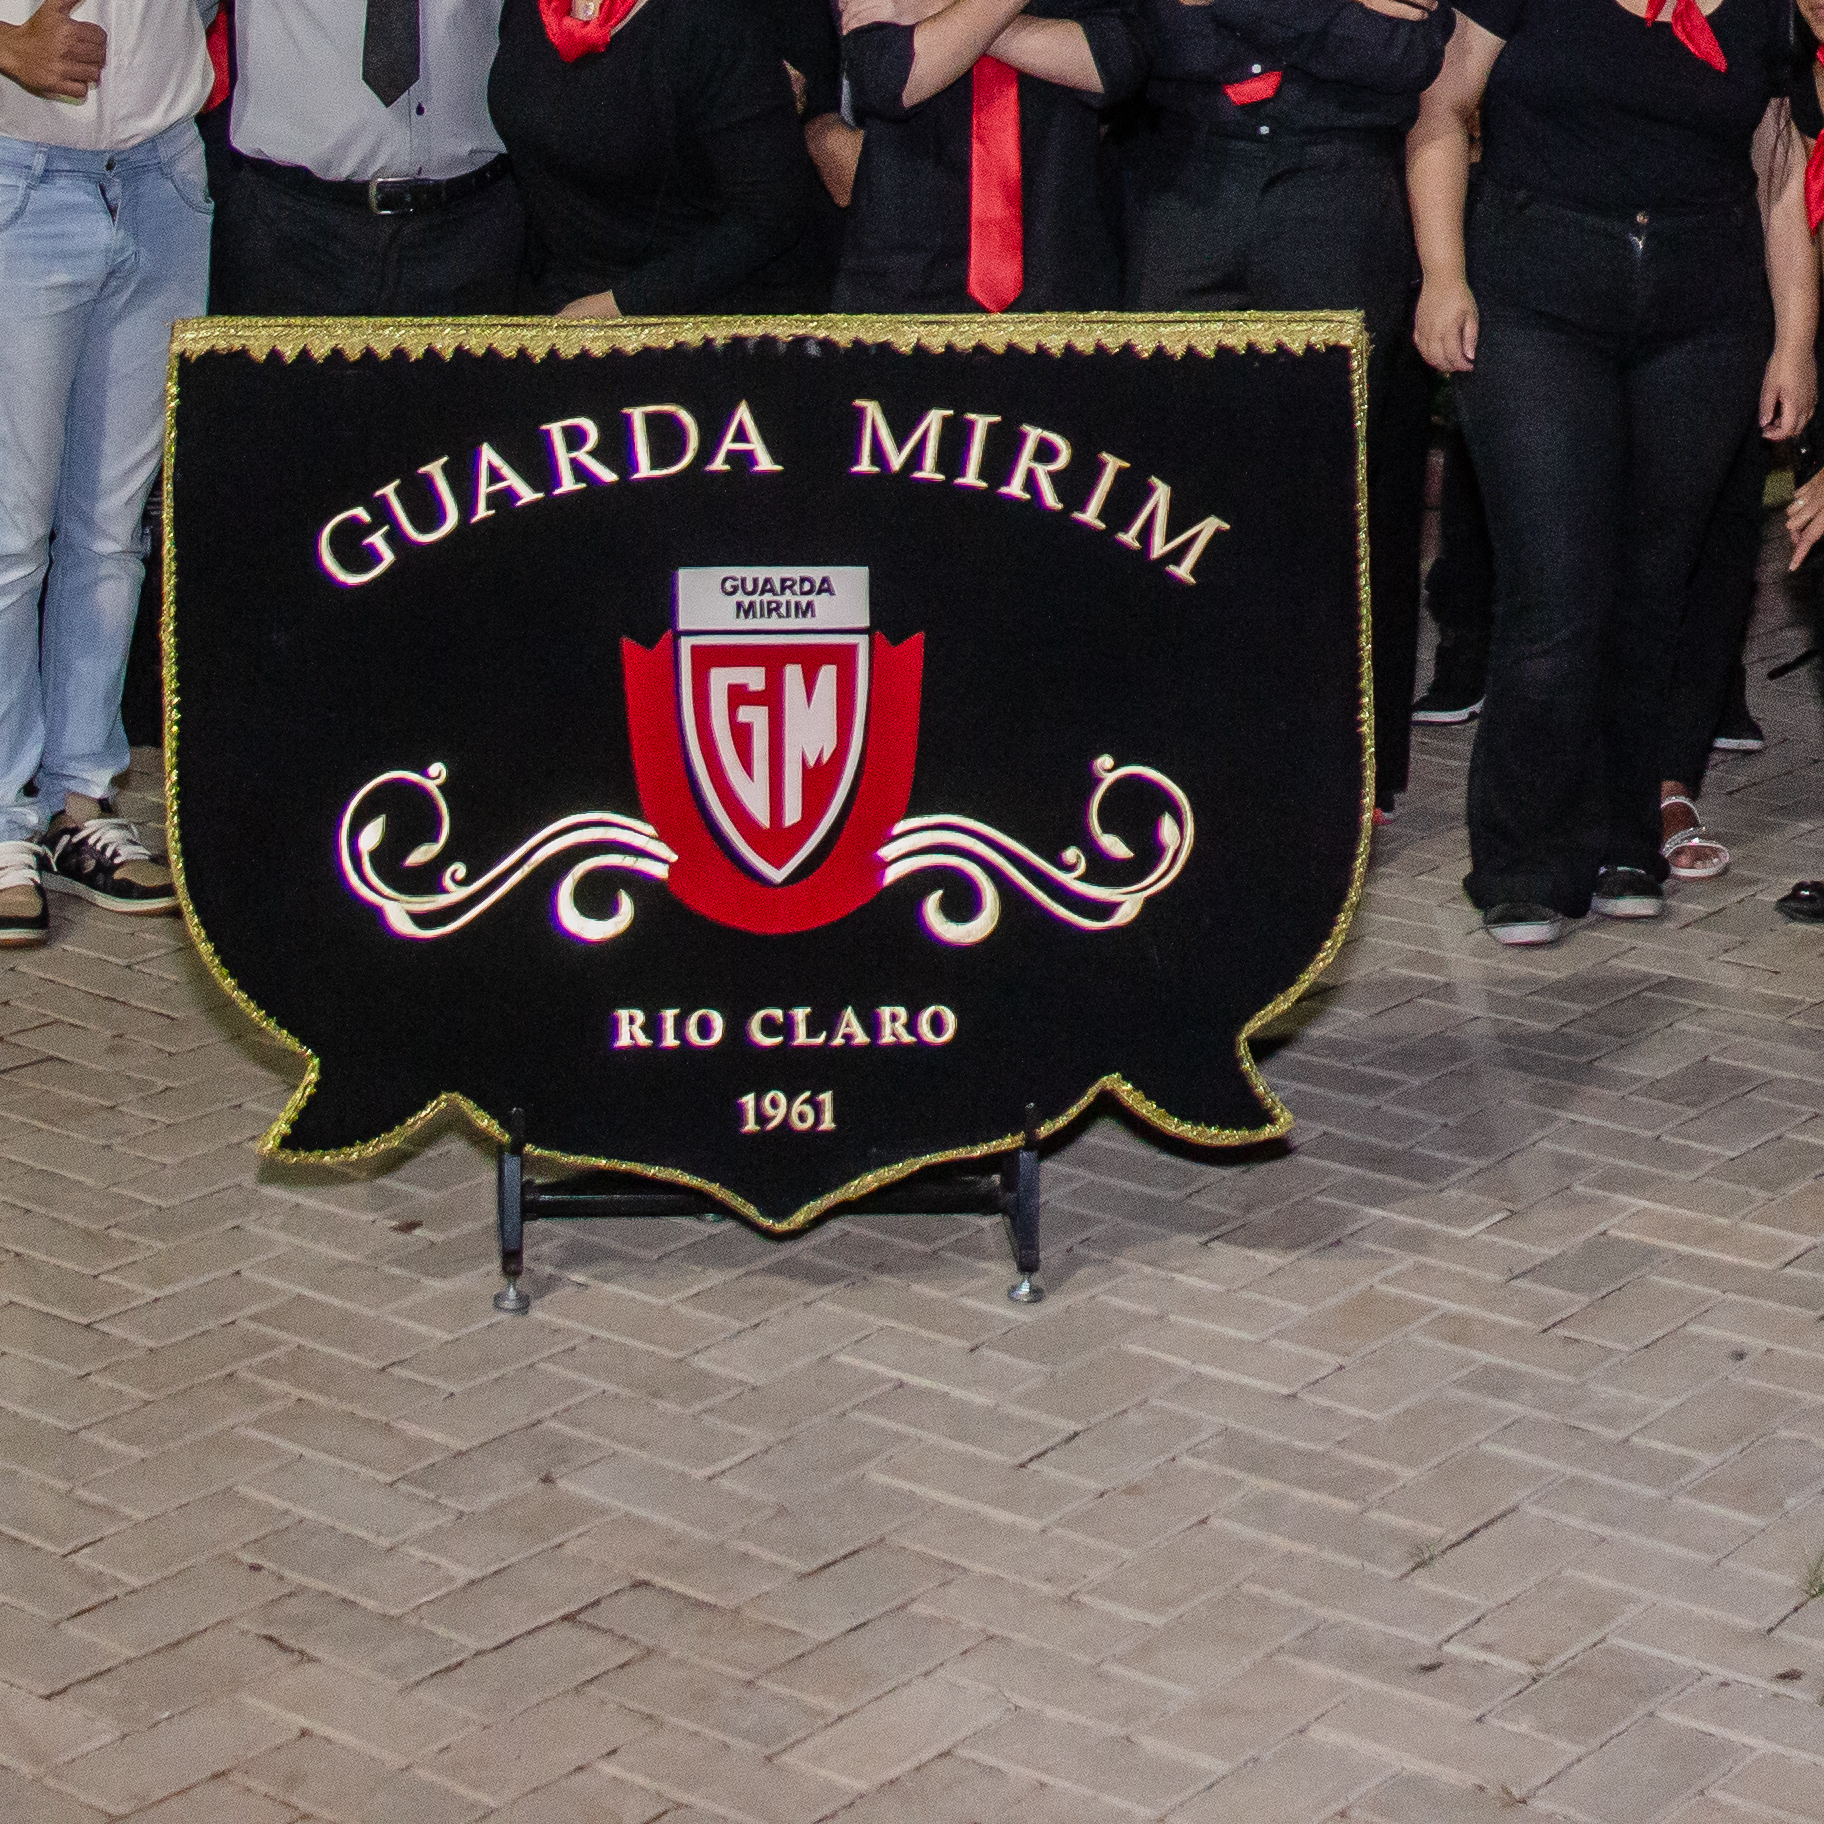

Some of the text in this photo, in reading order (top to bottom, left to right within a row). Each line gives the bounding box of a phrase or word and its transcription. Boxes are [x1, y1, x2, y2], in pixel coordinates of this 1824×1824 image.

[317, 398, 1231, 589] GUARDA MIRIM
[719, 575, 836, 597] GUARDA
[734, 599, 817, 620] MIRIM
[708, 663, 838, 829] GM
[613, 1004, 957, 1048] RIO CLARO
[739, 1089, 836, 1133] 1961
